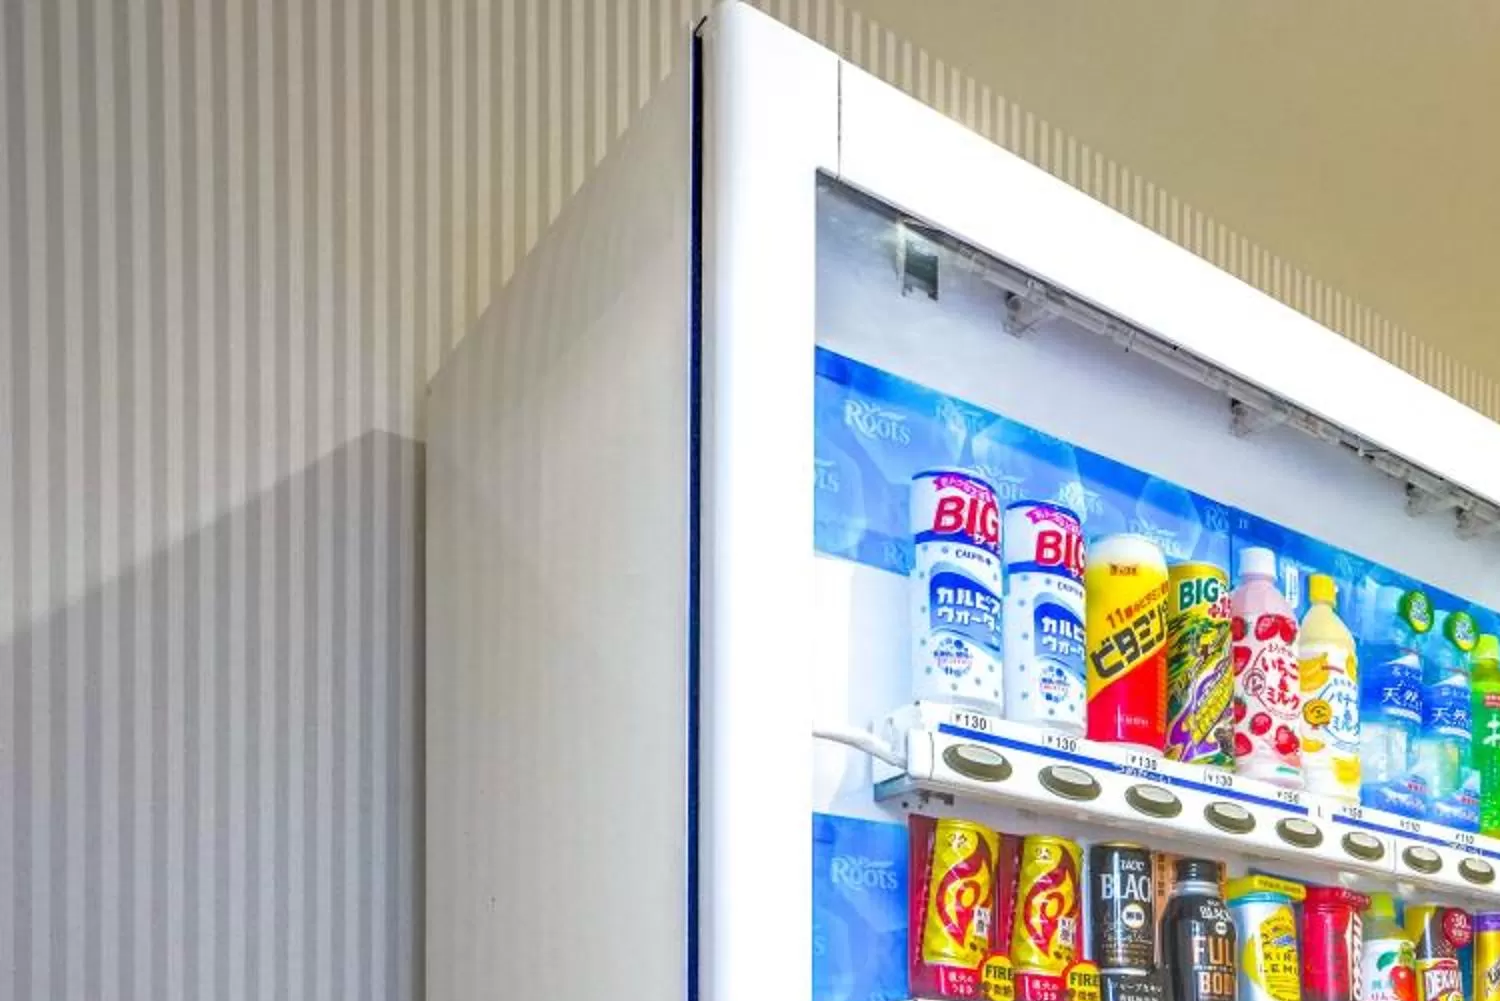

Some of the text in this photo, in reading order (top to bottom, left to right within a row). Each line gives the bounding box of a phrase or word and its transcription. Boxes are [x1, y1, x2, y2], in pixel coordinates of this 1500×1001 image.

[933, 496, 999, 543] BIG
[1179, 578, 1219, 611] BIG
[1042, 616, 1085, 638] カルピ
[955, 713, 987, 731] ¥130
[1100, 873, 1151, 902] BLAC
[1194, 936, 1233, 965] FUL
[986, 965, 1014, 982] FIRE
